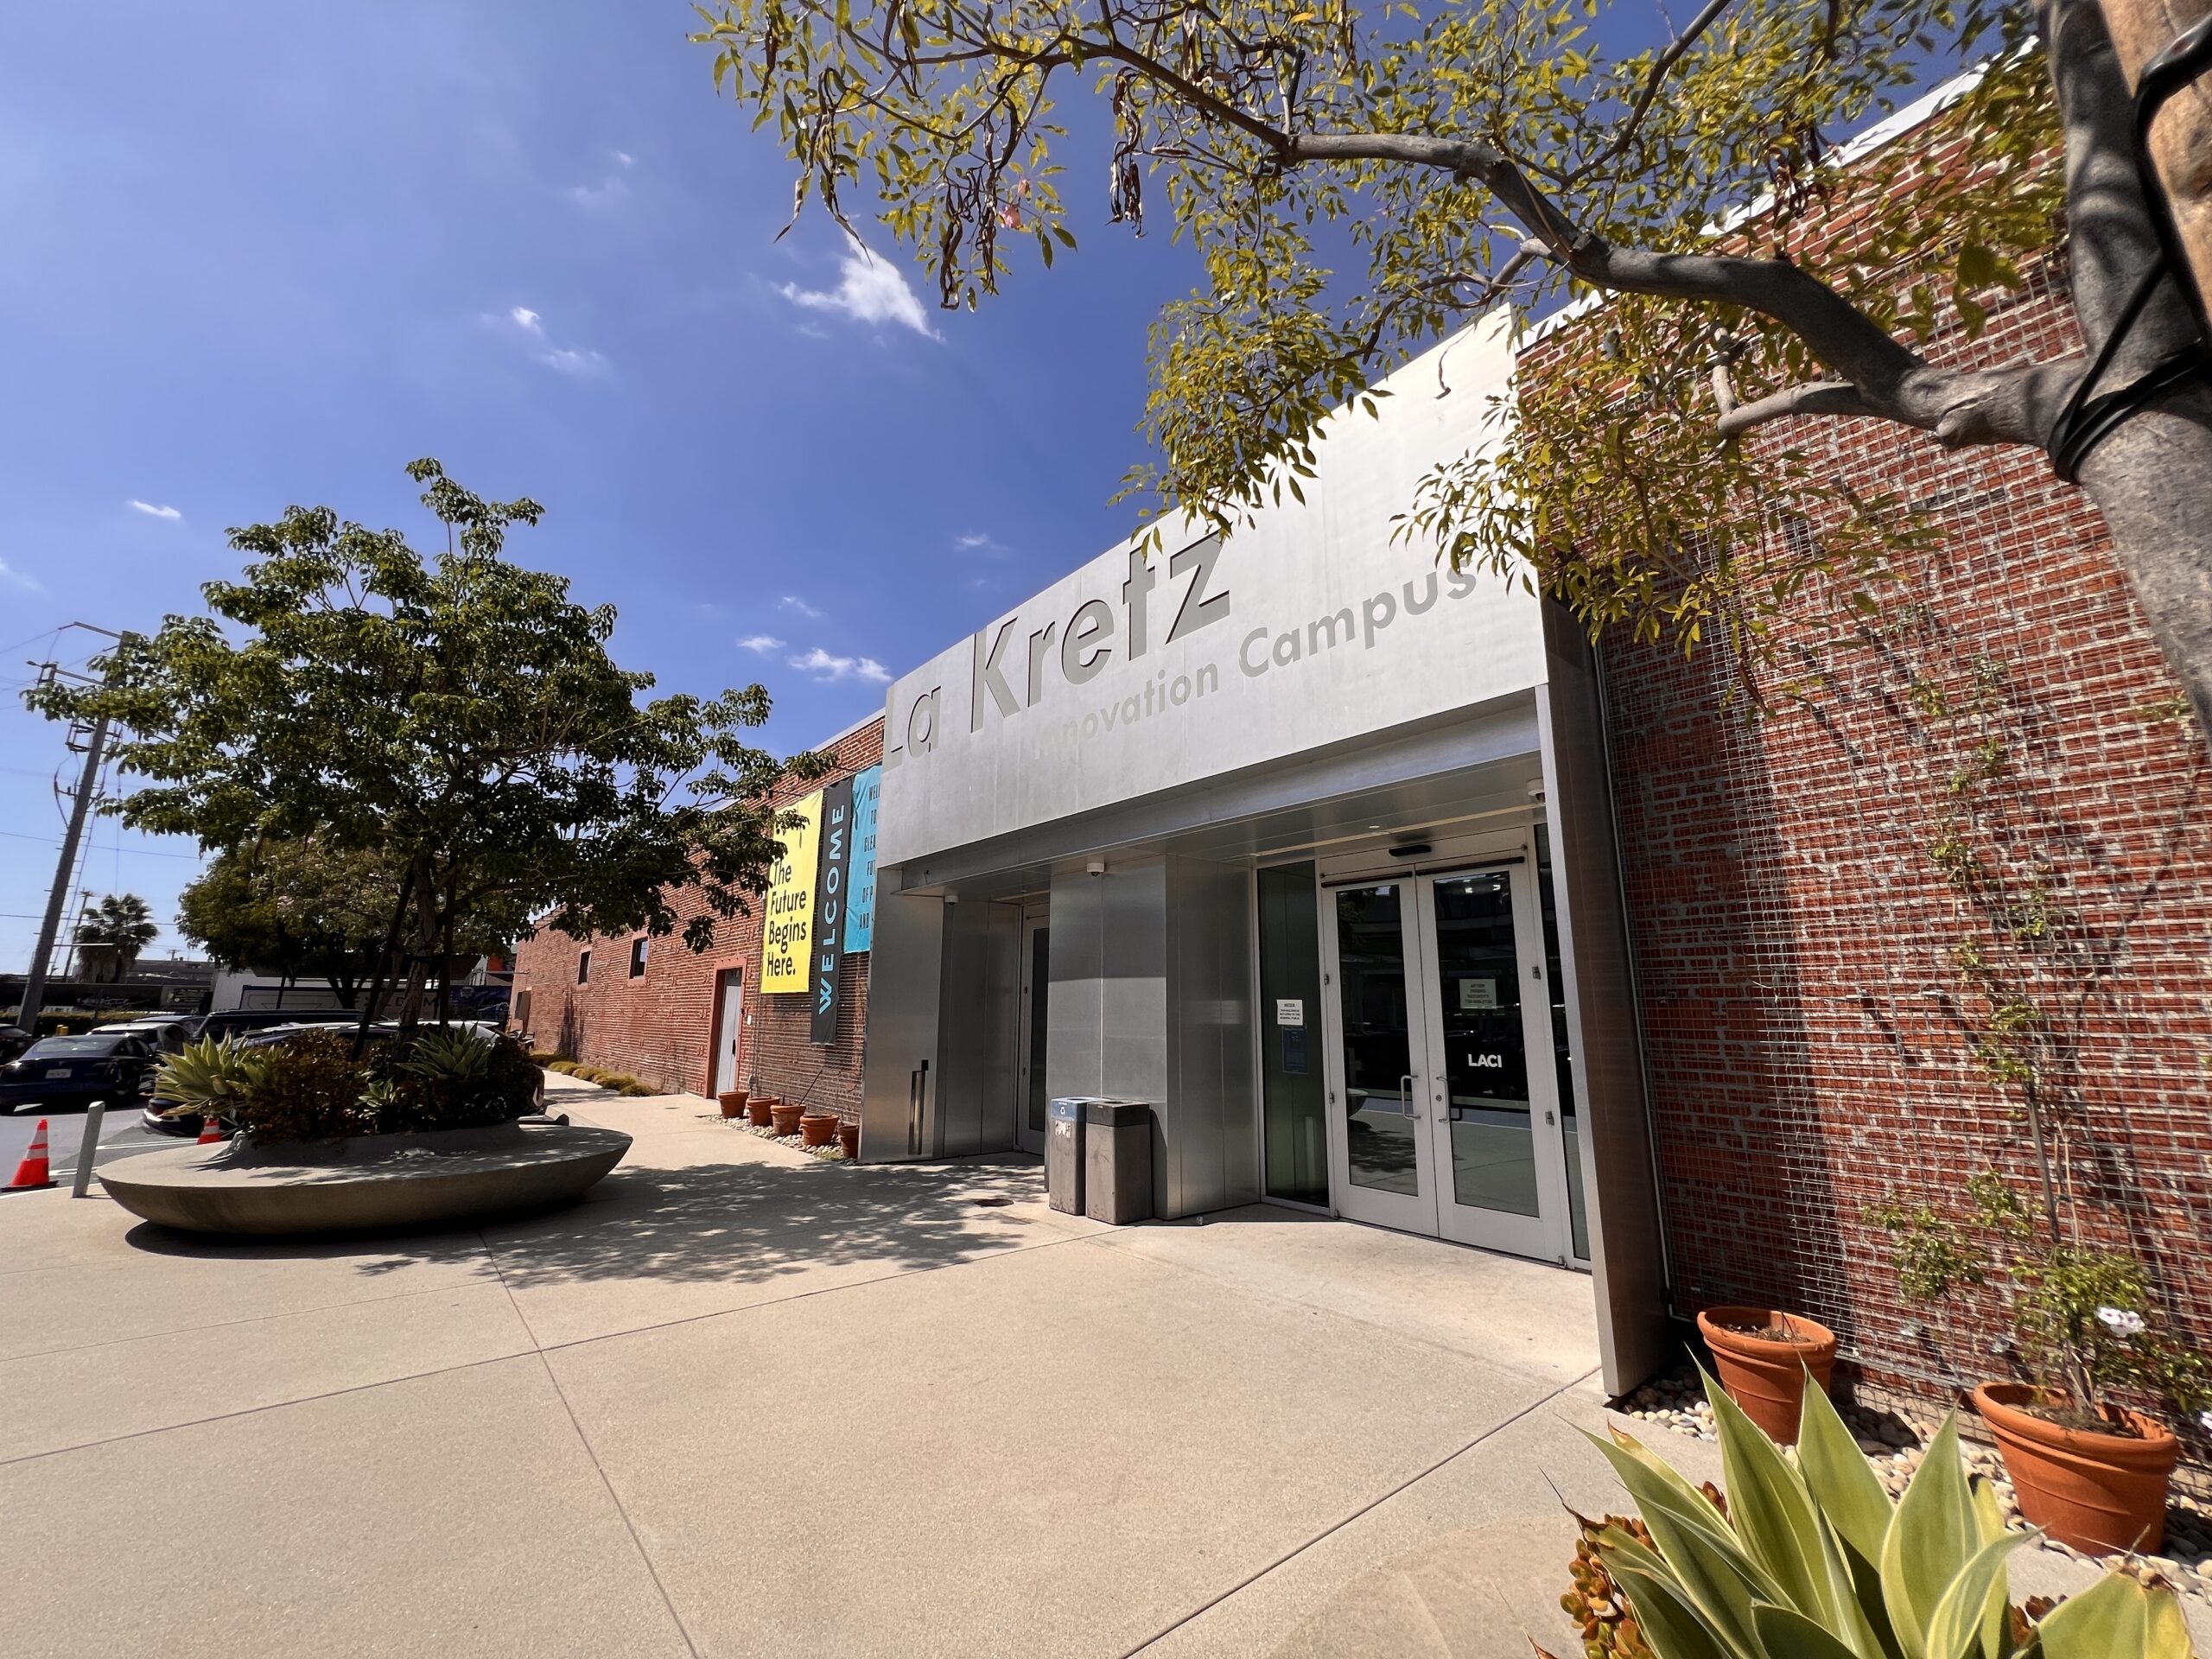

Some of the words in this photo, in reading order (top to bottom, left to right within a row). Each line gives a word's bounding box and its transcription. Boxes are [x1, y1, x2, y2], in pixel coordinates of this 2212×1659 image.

[1239, 560, 1477, 677] Campus
[882, 685, 941, 774] La
[971, 529, 1230, 734] Kretz
[772, 860, 791, 887] The
[770, 889, 806, 916] Future
[819, 804, 844, 1014] WELCOME
[768, 916, 806, 954] Begins
[766, 951, 796, 976] Here.
[1468, 1053, 1502, 1068] LACI
